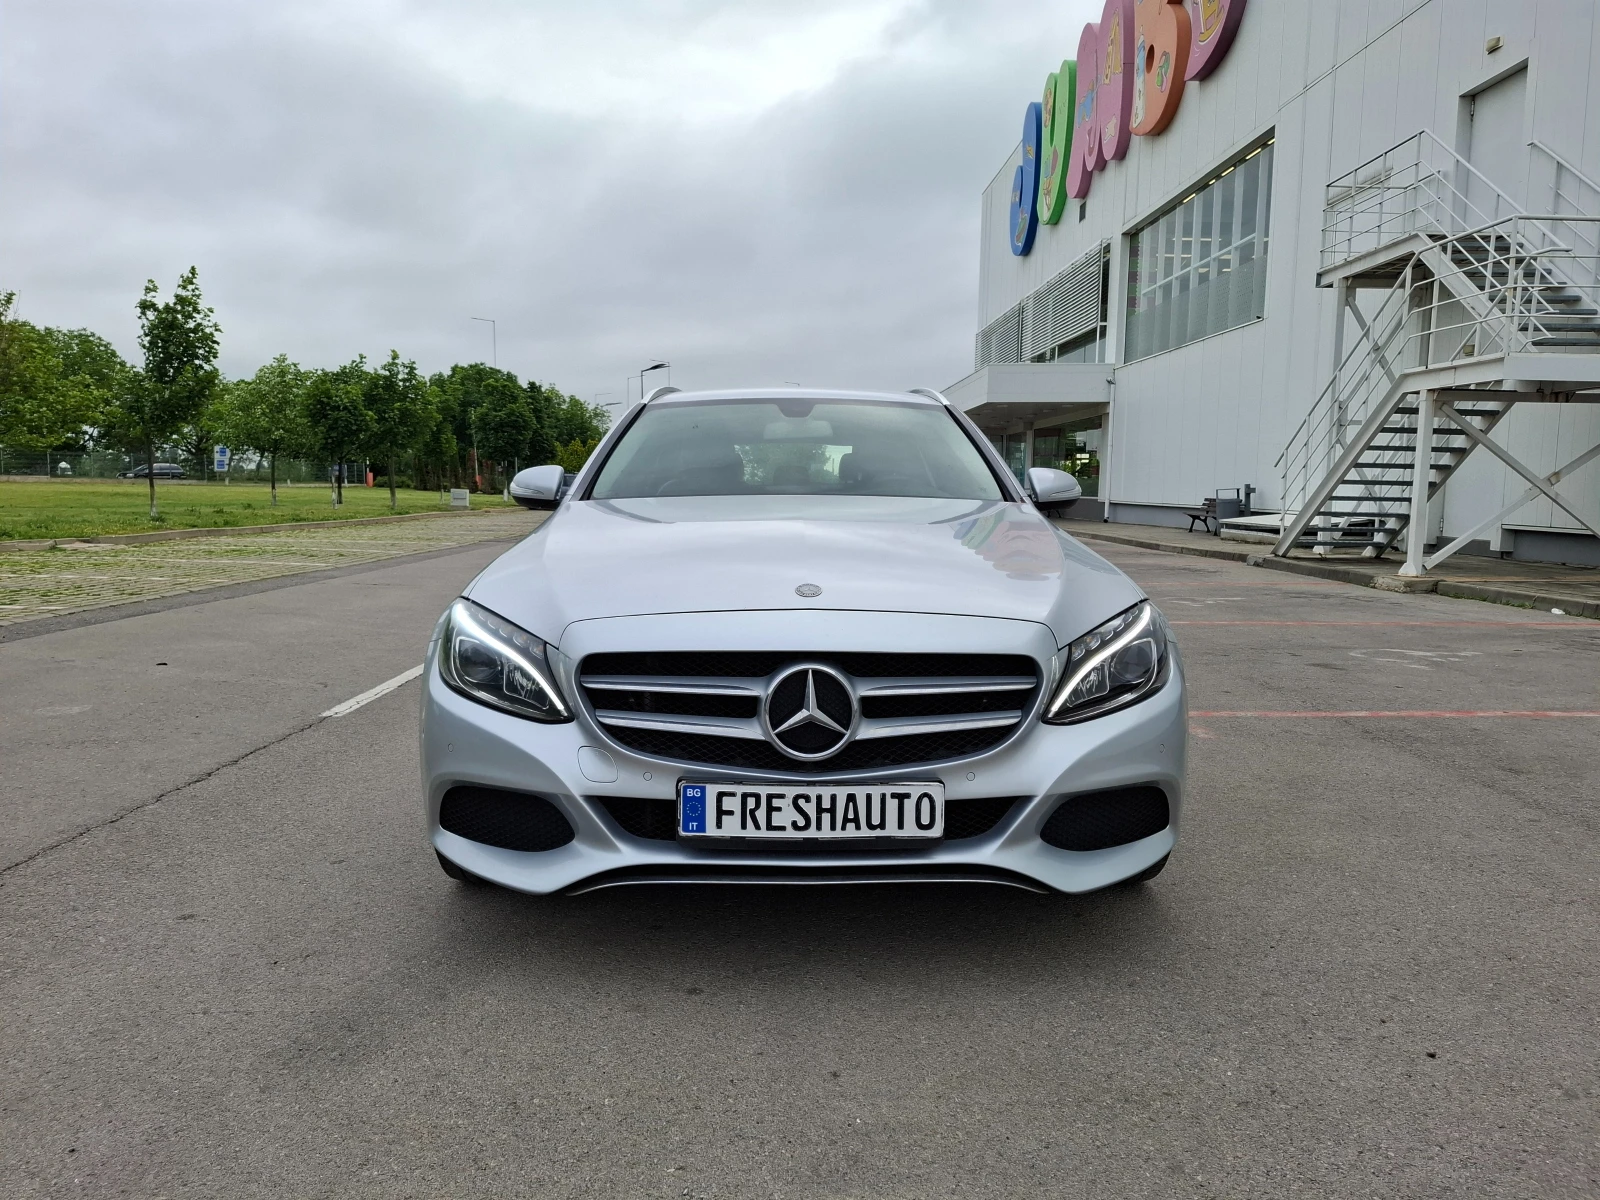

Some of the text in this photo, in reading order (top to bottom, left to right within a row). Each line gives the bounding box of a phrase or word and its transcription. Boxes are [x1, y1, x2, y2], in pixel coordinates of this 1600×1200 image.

[686, 788, 702, 797] BG
[715, 790, 936, 832] FRESHAUTO
[689, 822, 699, 831] IT
